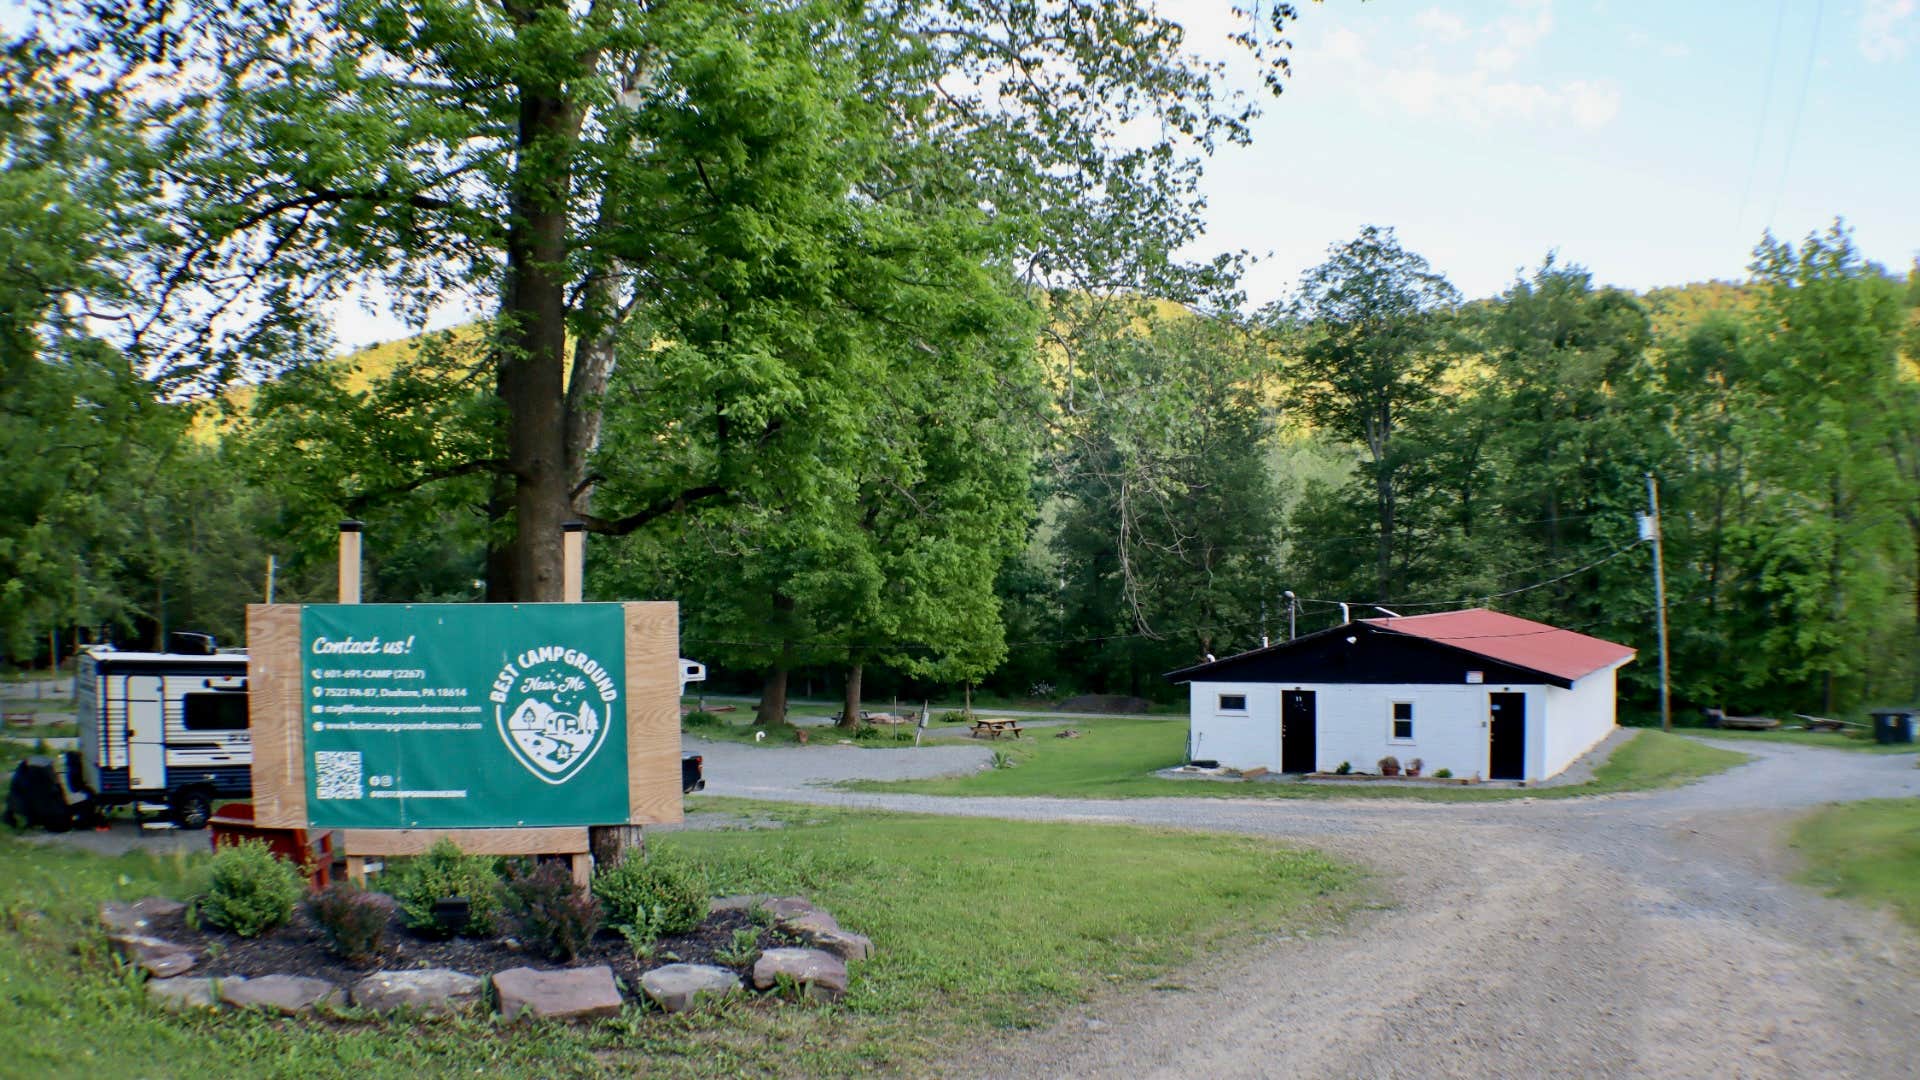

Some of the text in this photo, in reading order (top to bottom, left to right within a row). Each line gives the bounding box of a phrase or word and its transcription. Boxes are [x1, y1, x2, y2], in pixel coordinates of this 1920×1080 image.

[312, 635, 415, 655] Contact us!
[490, 646, 618, 703] BEST CAMPGROUND
[324, 688, 348, 697] 7522
[422, 688, 436, 697] PA
[437, 688, 468, 697] 18614
[520, 676, 586, 693] Near Me
